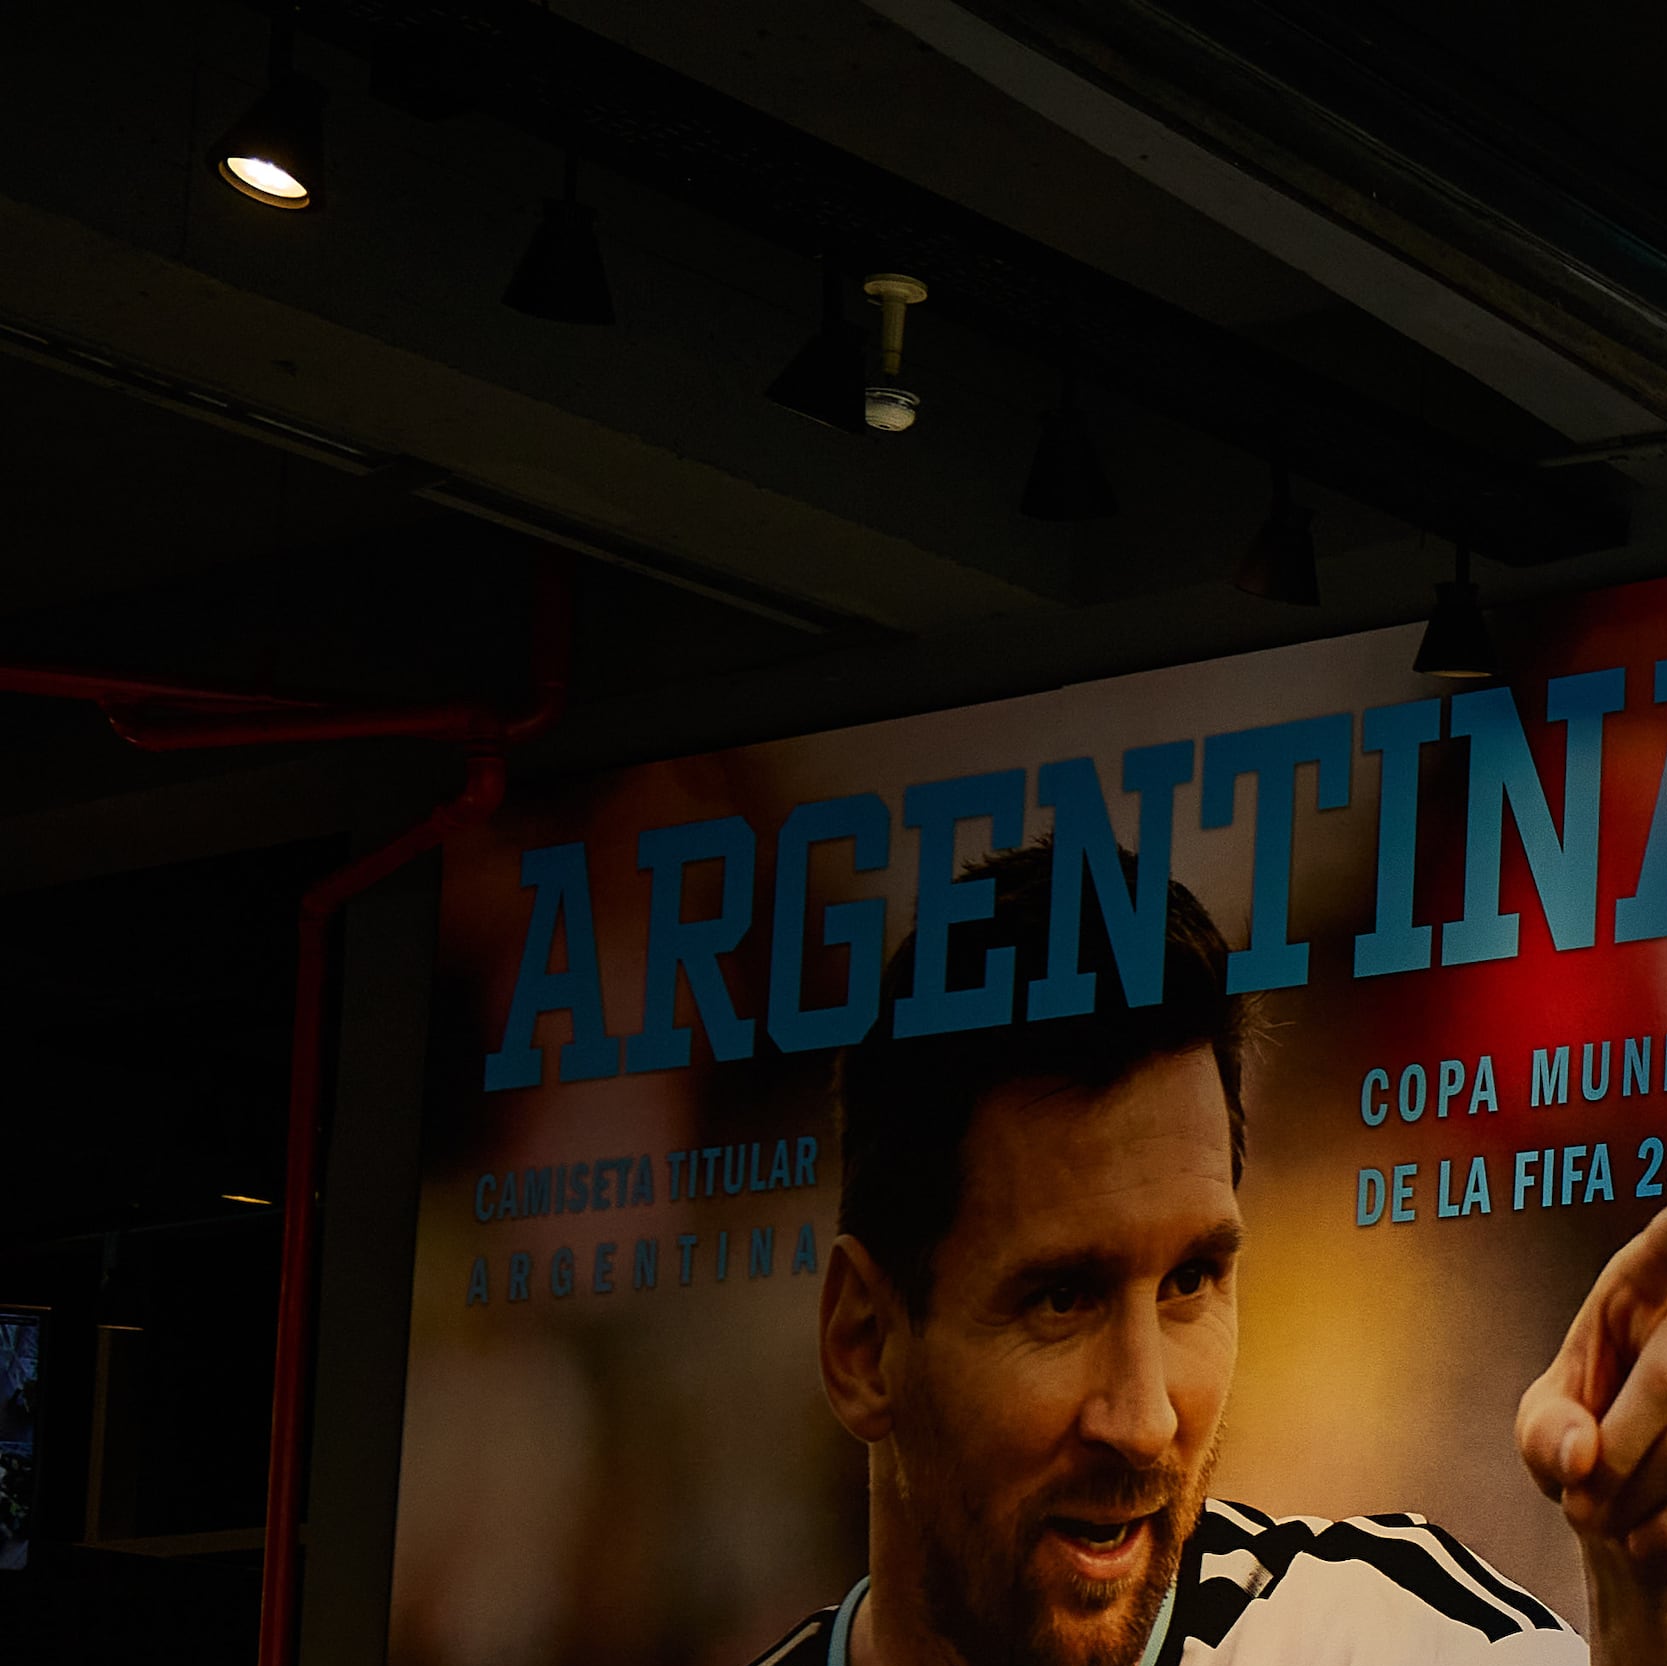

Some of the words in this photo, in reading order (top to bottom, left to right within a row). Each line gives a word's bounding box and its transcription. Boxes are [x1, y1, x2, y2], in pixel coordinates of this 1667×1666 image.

[1358, 1049, 1500, 1127] COPA
[474, 1153, 655, 1223] CAMISETA
[667, 1135, 819, 1201] TITULAR
[1355, 1166, 1416, 1228] DE
[1436, 1160, 1493, 1220] LA
[1511, 1142, 1615, 1212] FIFA
[466, 1221, 818, 1305] ARGENTINA
